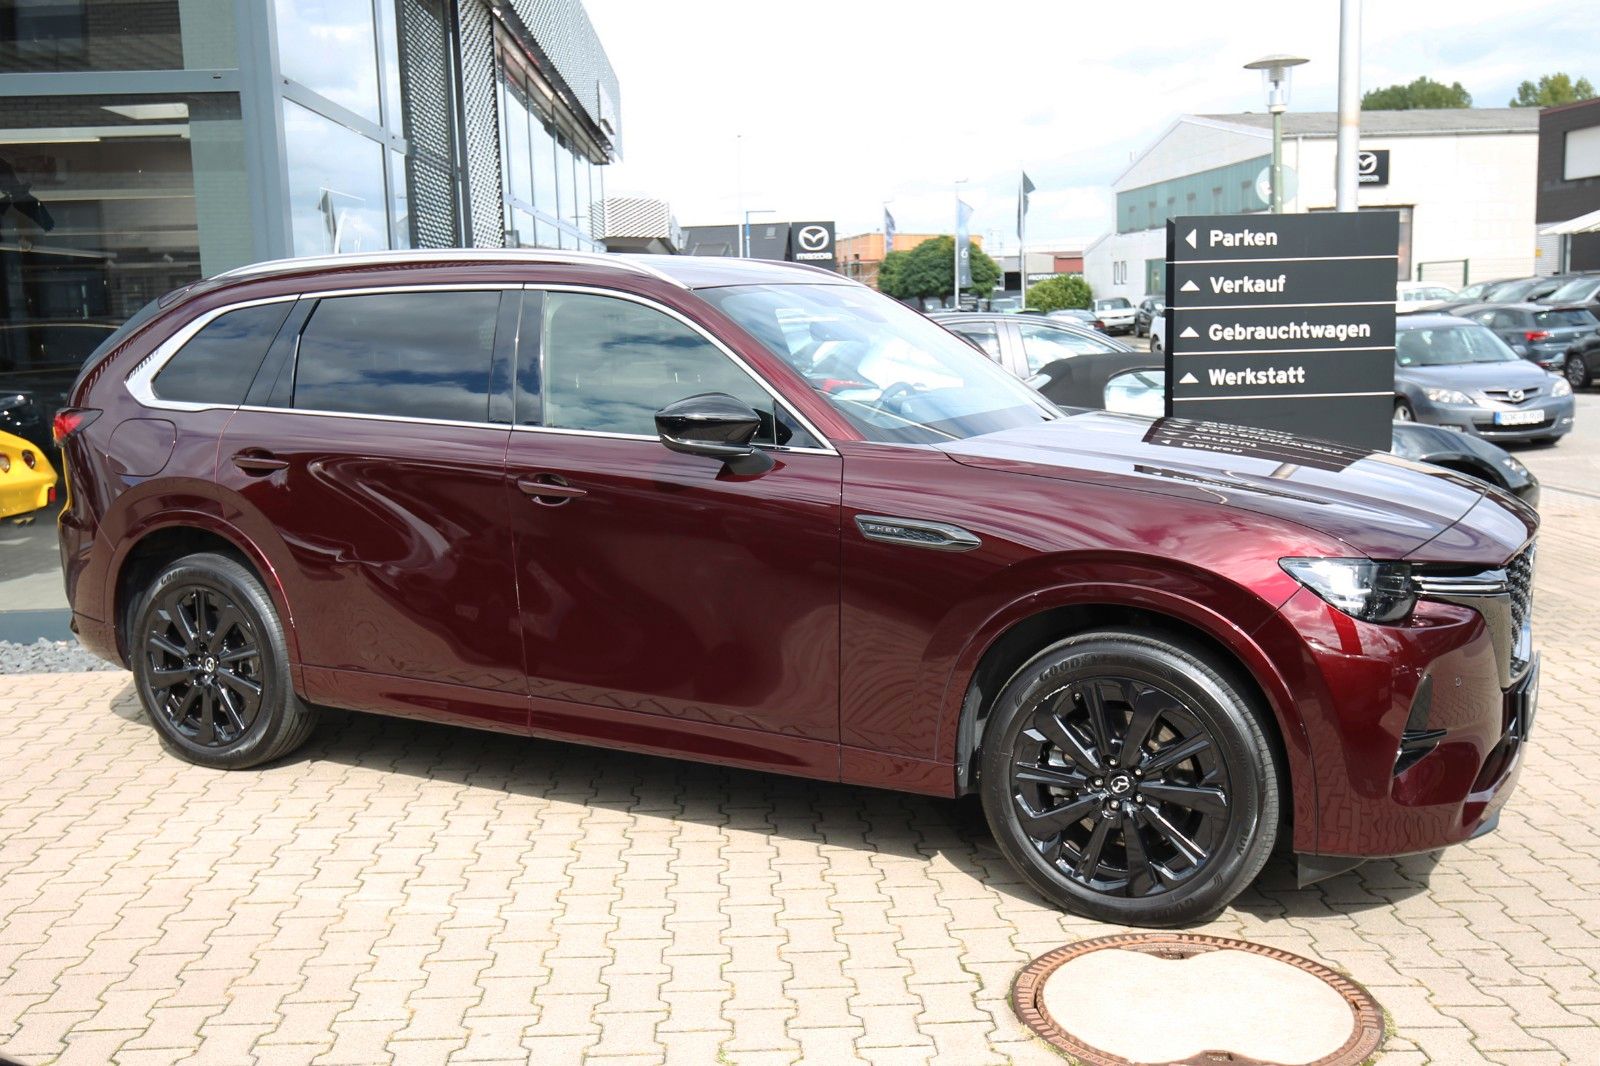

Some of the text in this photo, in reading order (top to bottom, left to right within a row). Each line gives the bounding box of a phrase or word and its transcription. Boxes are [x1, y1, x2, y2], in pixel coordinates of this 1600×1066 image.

[1209, 229, 1278, 247] Parken
[796, 252, 833, 260] mazda
[1209, 274, 1286, 293] Verkauf
[1208, 321, 1371, 341] Gebrauchtwagen
[1208, 366, 1305, 386] Werkstatt
